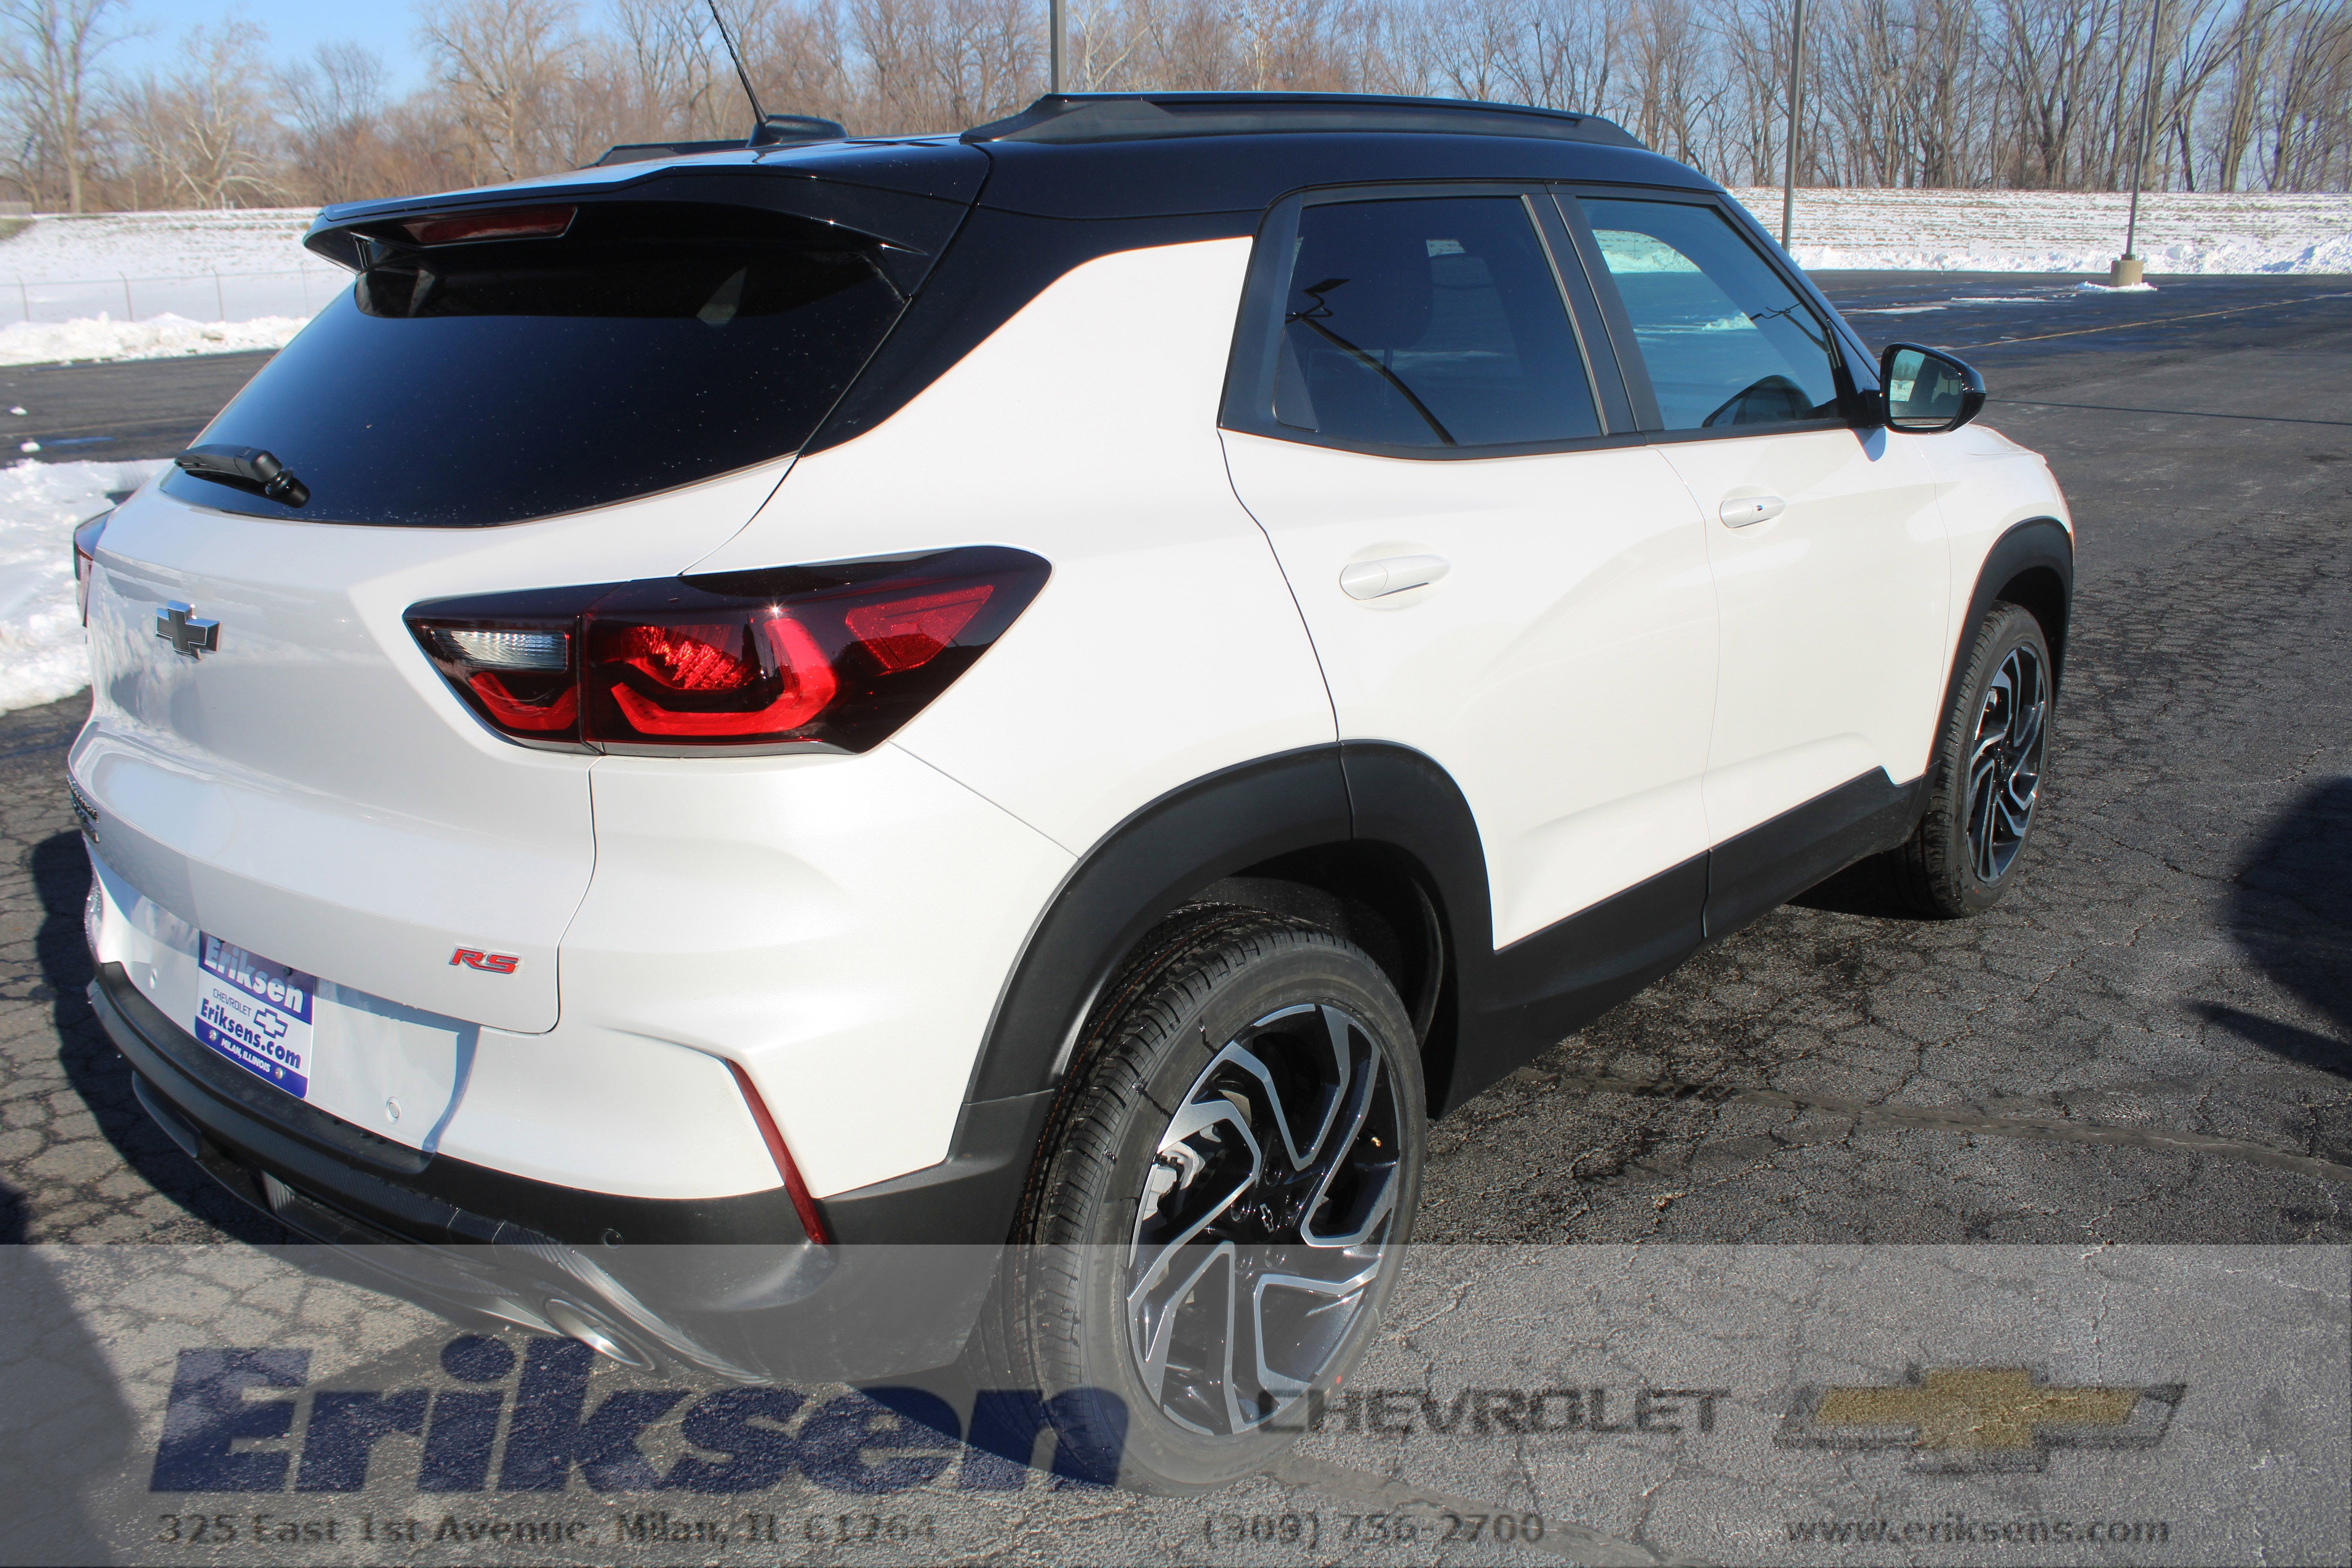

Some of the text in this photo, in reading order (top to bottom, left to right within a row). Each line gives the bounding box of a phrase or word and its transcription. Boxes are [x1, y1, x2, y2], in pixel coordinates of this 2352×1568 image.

[204, 935, 304, 1013] Eriksen
[448, 947, 521, 974] RS
[213, 988, 252, 1017] CHEVROLET
[200, 997, 302, 1069] Eriksens.com
[221, 1038, 271, 1073] MILAN, ILLINOIS
